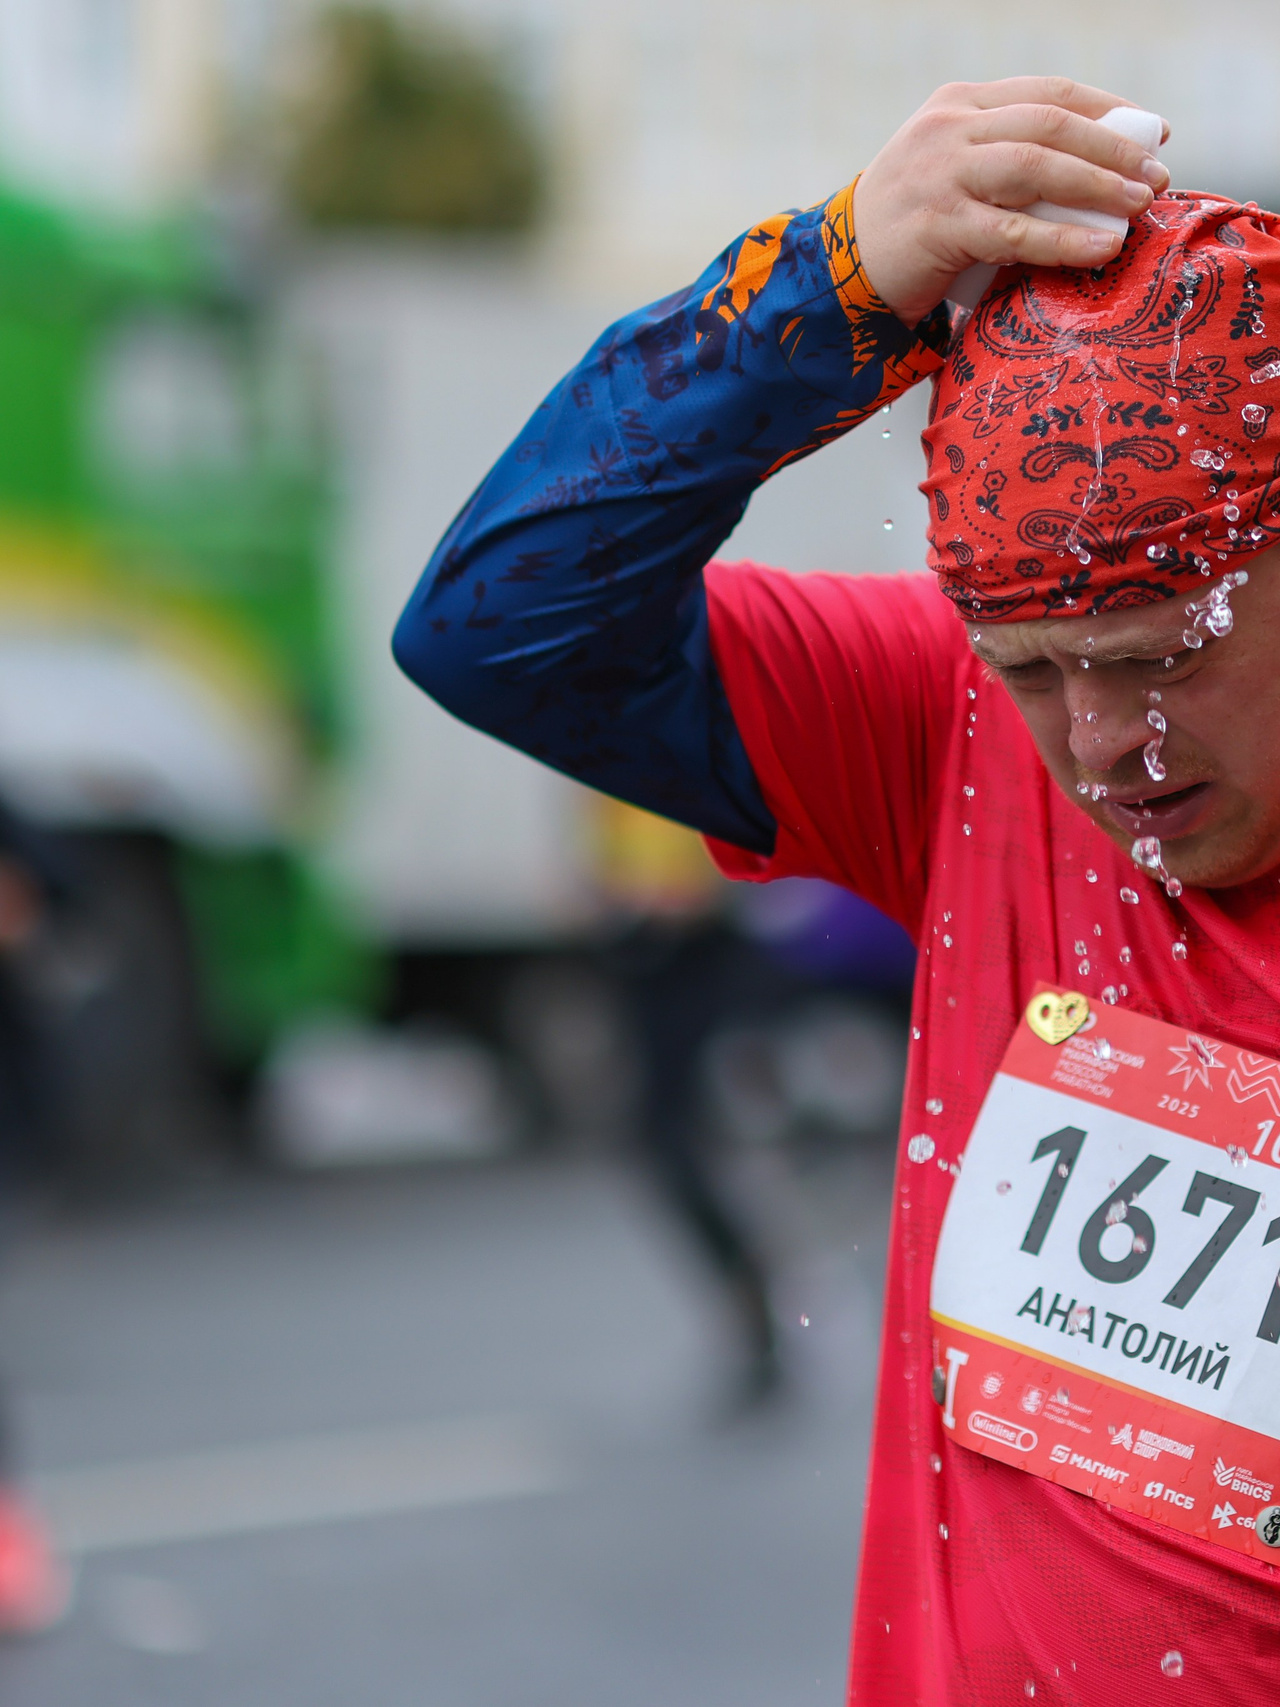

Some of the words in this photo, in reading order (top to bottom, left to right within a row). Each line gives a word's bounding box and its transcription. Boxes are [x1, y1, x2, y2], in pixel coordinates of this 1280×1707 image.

[1056, 1058, 1109, 1082] MOSCOW
[1051, 1070, 1114, 1098] MARATHON
[1157, 1094, 1200, 1118] 2025
[1016, 1286, 1232, 1392] АНАТОЛИЙ
[1132, 1441, 1162, 1461] СПОРТ
[1069, 1453, 1130, 1484] МАГНИТ
[1163, 1489, 1195, 1510] ПСБ
[1231, 1478, 1272, 1502] BRICS
